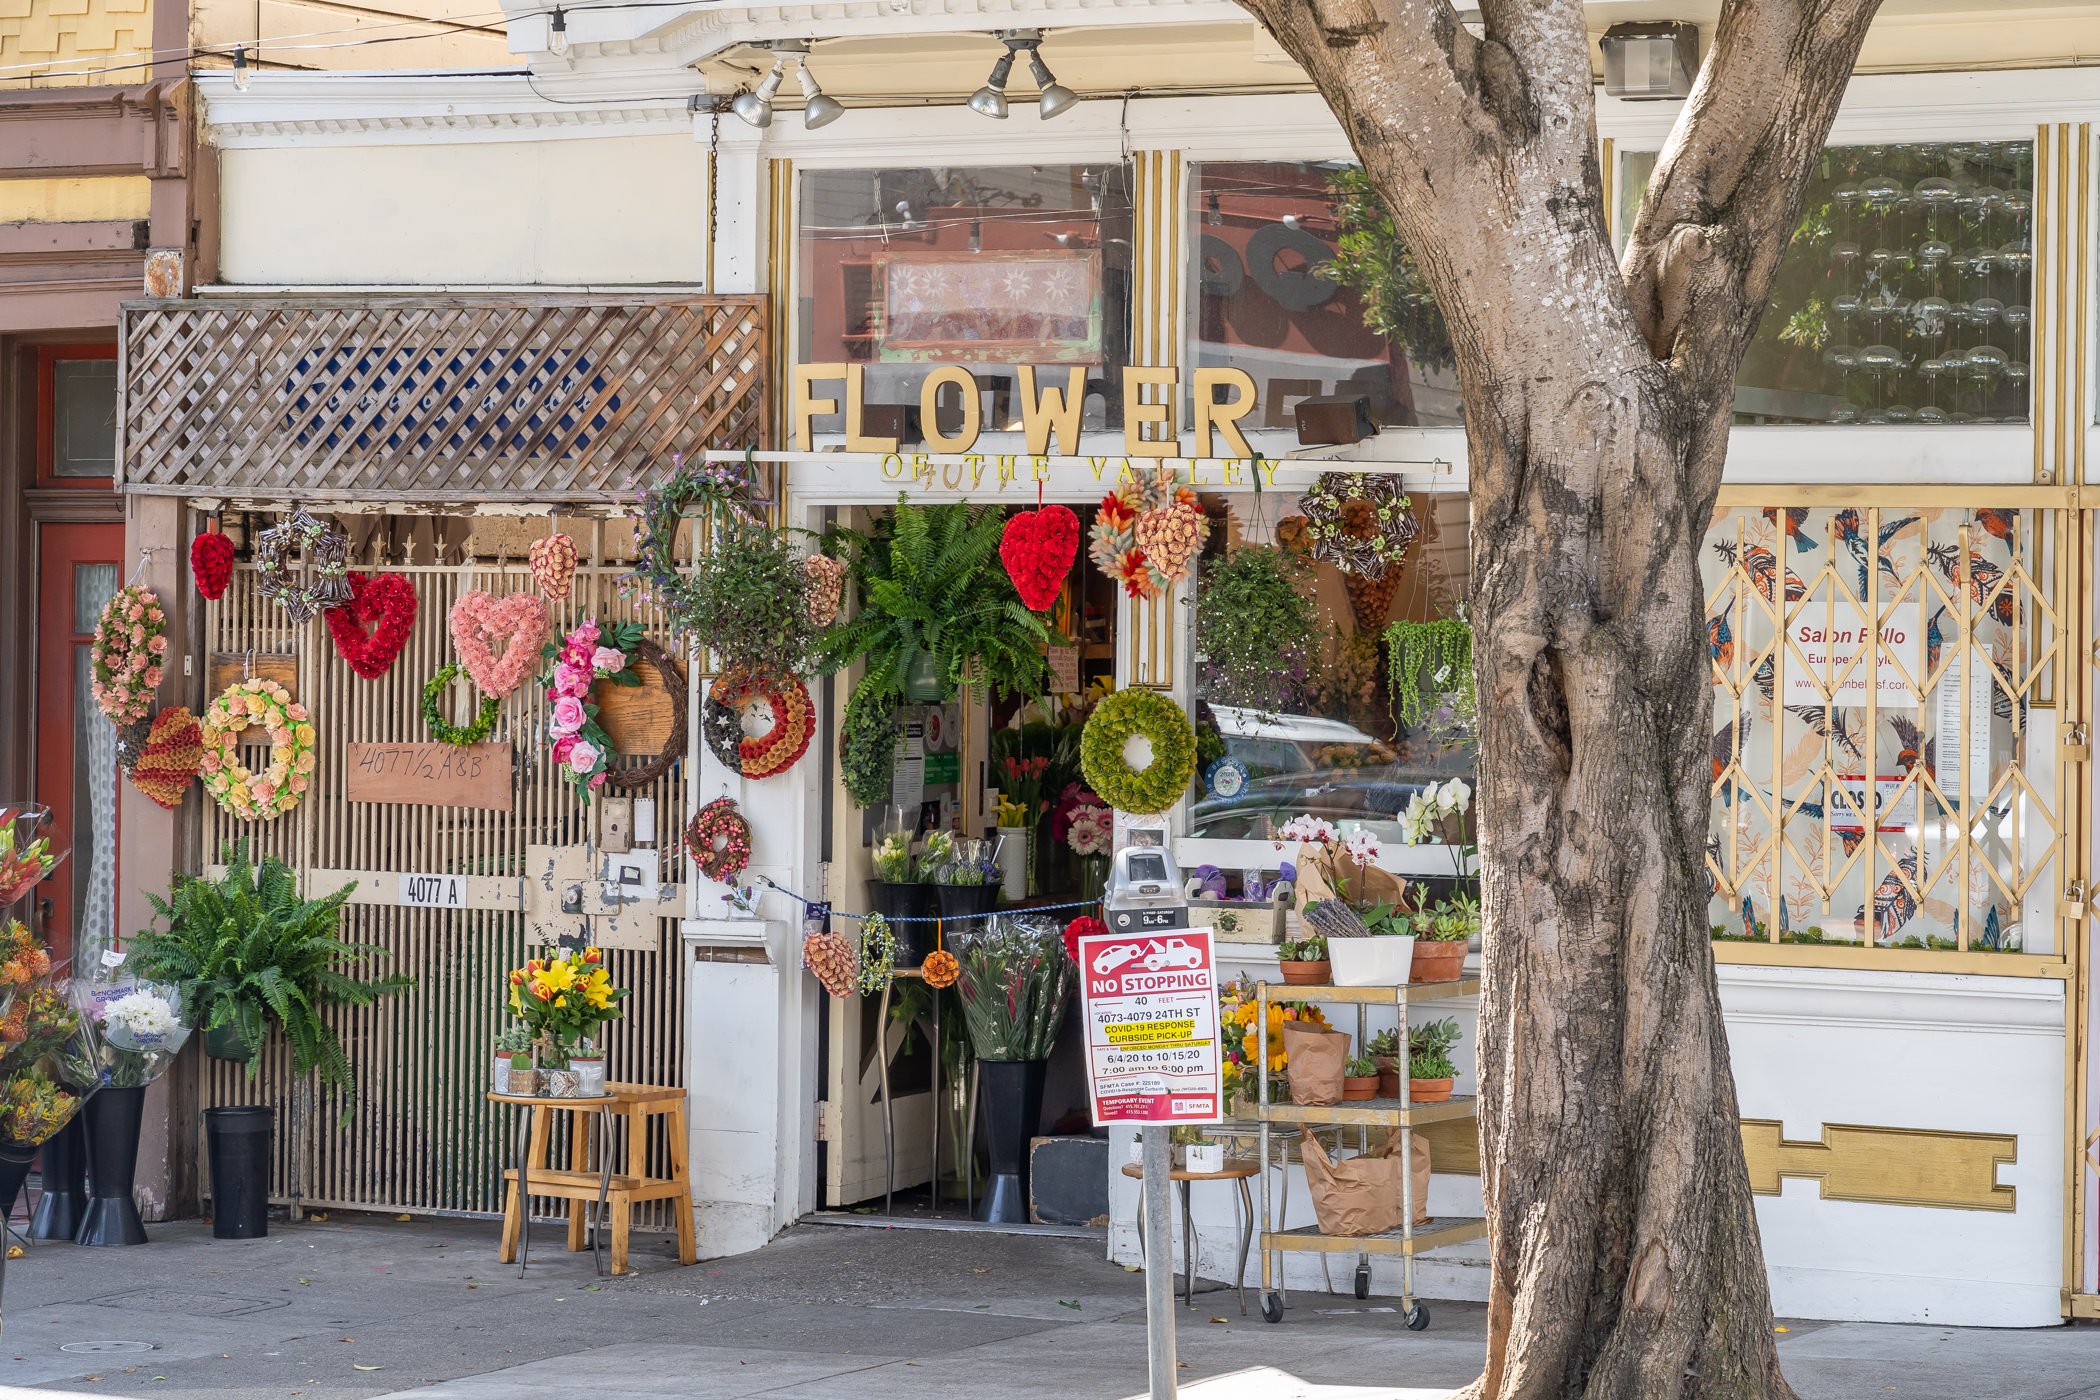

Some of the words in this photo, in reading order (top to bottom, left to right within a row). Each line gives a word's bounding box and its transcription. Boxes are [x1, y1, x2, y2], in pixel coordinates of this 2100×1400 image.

[795, 363, 1259, 458] FLOWER
[881, 453, 929, 480] OF
[964, 455, 1050, 482] THE
[1088, 457, 1280, 487] VALLEY
[1799, 626, 1852, 644] Salon
[1858, 627, 1906, 644] Bllo
[1808, 653, 1862, 666] Eurpen
[1831, 790, 1882, 810] CLOSD
[408, 876, 442, 904] 4077
[448, 878, 458, 904] A
[1092, 980, 1118, 994] NO
[1125, 974, 1207, 991] STOPPING
[96, 992, 127, 1002] GROWE
[1134, 996, 1148, 1006] 40
[1098, 1012, 1152, 1024] 4073-4079
[1155, 1009, 1183, 1020] 24TH
[1186, 1008, 1200, 1018] ST
[1104, 1024, 1144, 1034] COVID-19
[1147, 1020, 1195, 1031] RESPONSE
[1109, 1034, 1154, 1043] CURBSIDE
[1156, 1030, 1192, 1040] PICK-UP
[1108, 1054, 1139, 1064] 6/4/20
[1142, 1053, 1153, 1062] to
[1156, 1050, 1200, 1061] 10/15/20
[1102, 1066, 1125, 1075] 7:00
[1161, 1064, 1184, 1073] 6:00
[1186, 1064, 1204, 1074] pm
[1102, 1098, 1138, 1106] TEMPORARY
